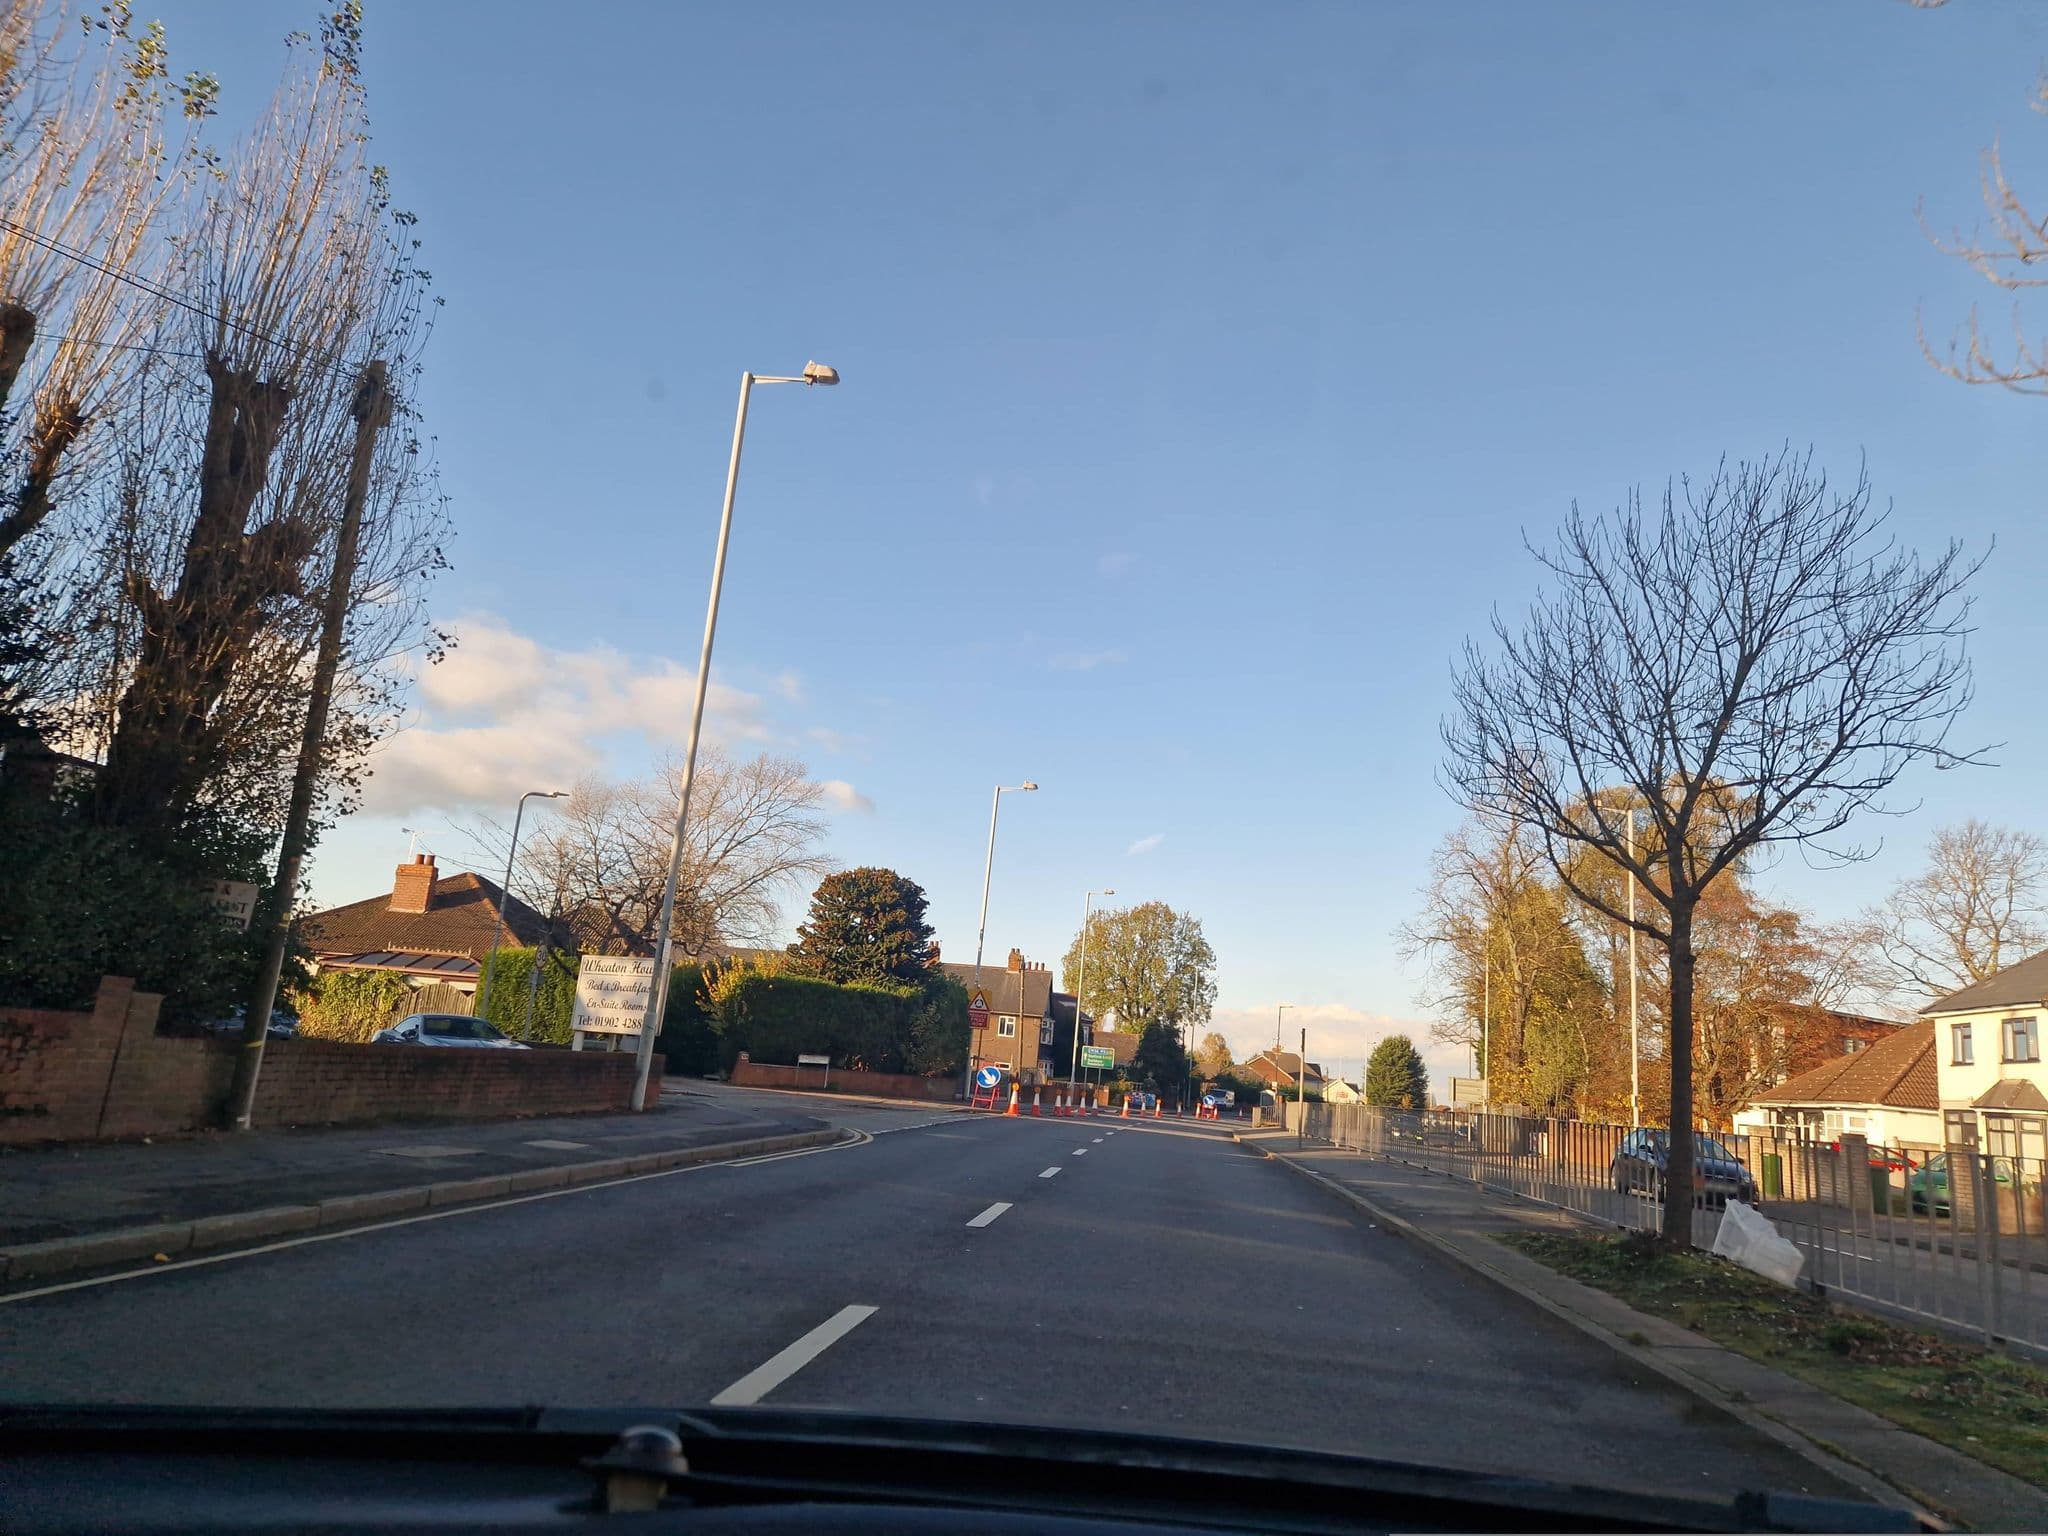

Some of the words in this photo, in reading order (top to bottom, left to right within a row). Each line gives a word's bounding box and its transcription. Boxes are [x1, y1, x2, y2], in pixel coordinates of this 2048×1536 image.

[584, 959, 627, 974] Wheaton
[629, 961, 653, 975] Hou
[585, 979, 604, 991] Bed
[611, 981, 652, 996] Breakfas
[586, 998, 618, 1010] En-Suite
[578, 1015, 593, 1027] Tel:
[595, 1016, 620, 1028] 01902
[622, 1018, 643, 1030] 4288
